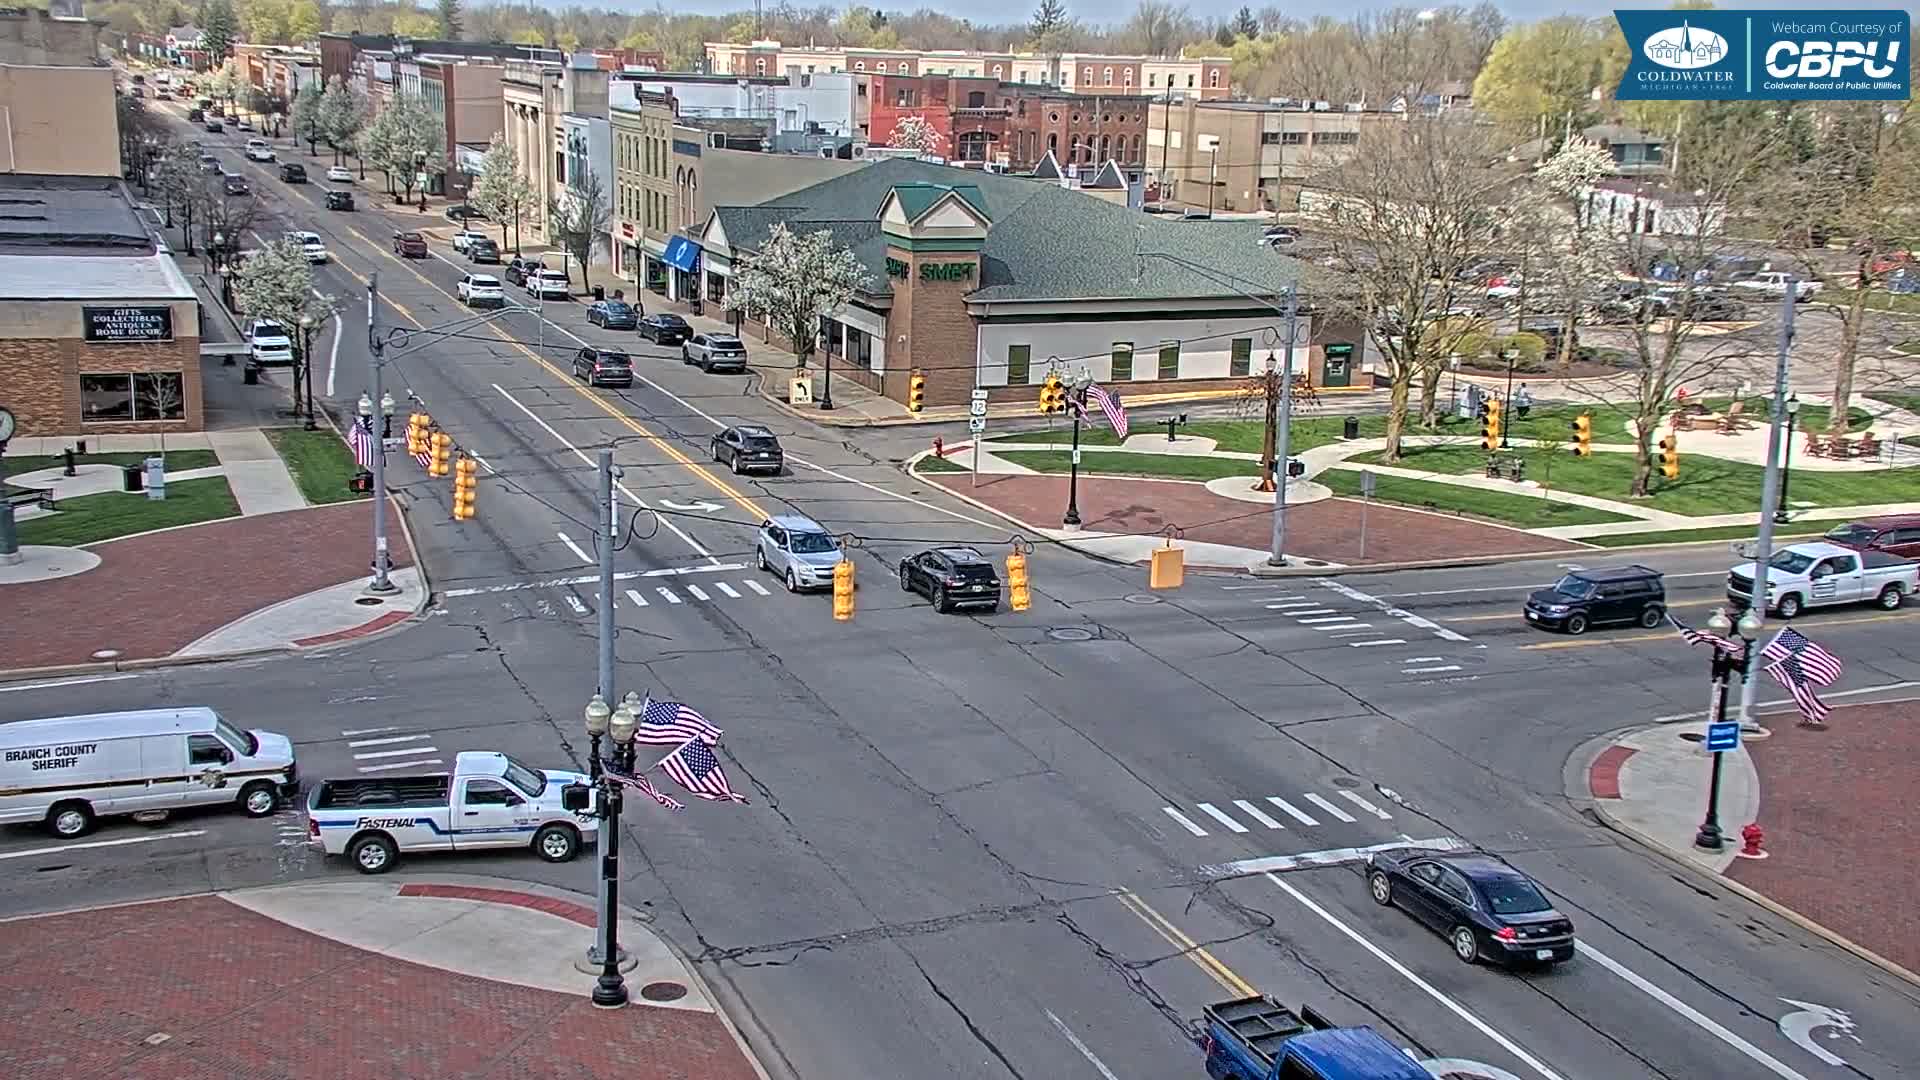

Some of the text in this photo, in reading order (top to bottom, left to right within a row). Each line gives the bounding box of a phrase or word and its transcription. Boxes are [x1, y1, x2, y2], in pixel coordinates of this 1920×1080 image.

[5, 744, 97, 761] BRANCH COUNTY
[32, 757, 78, 771] SHERIFF
